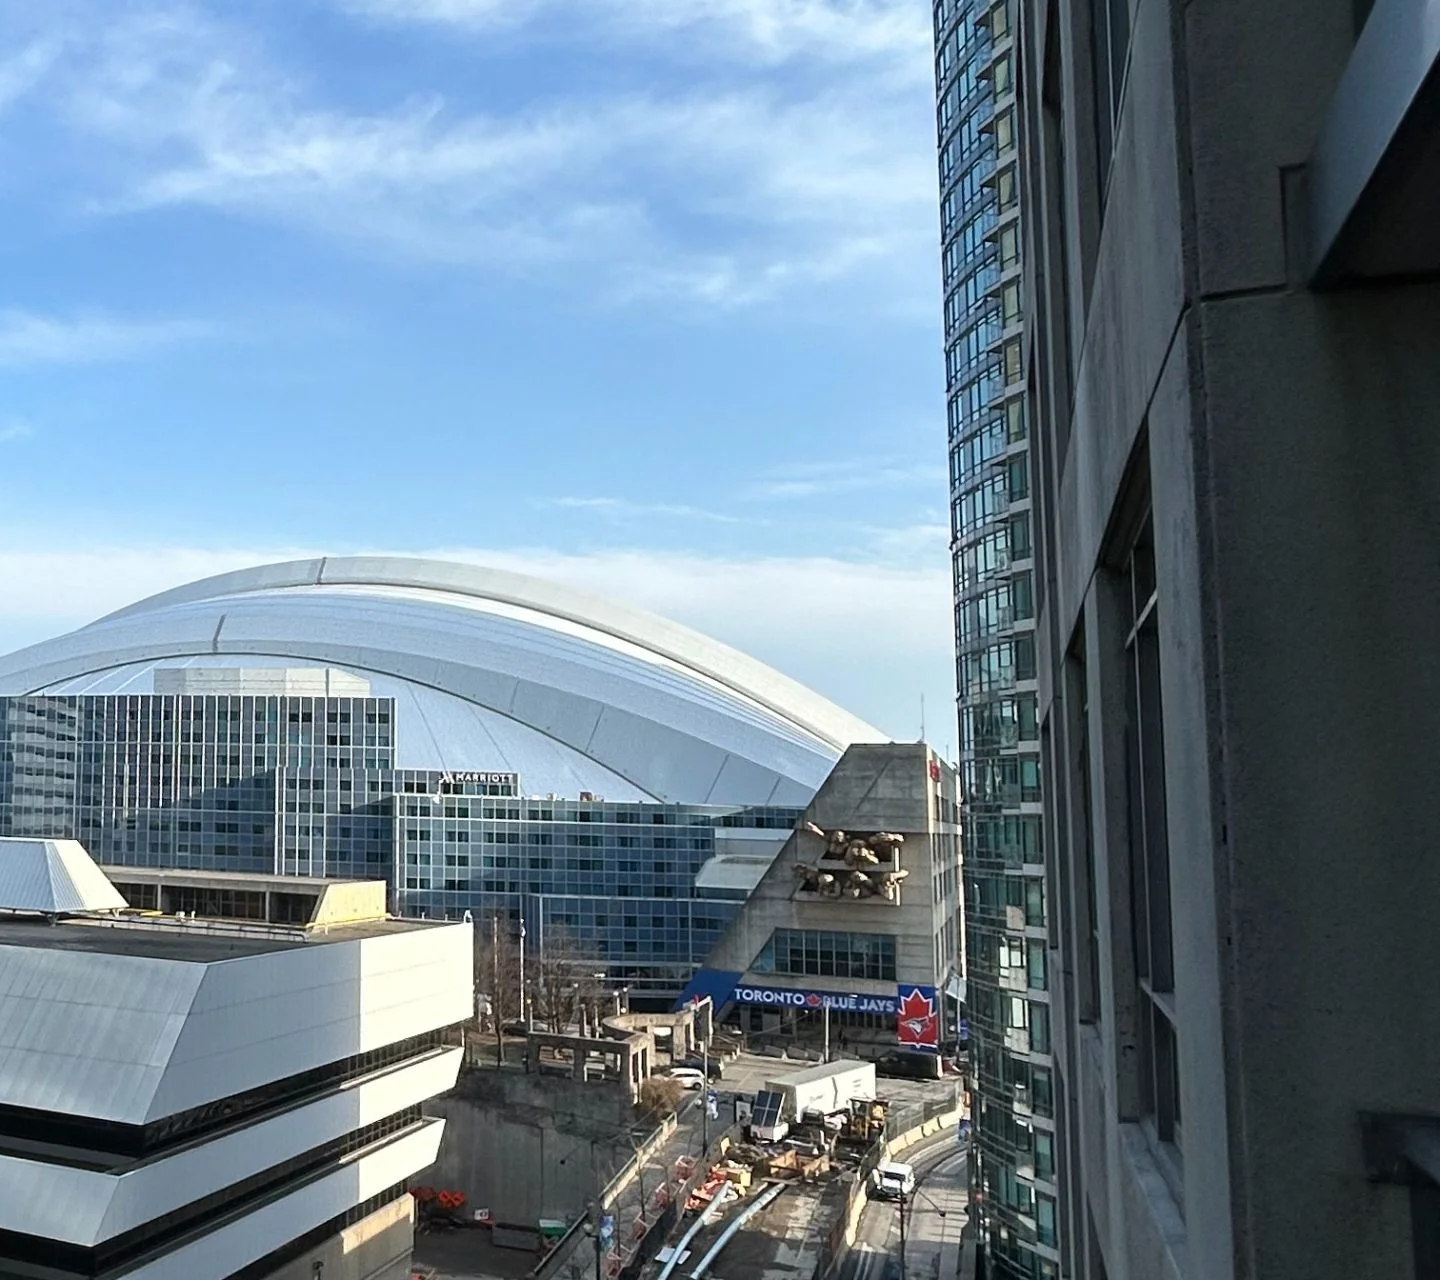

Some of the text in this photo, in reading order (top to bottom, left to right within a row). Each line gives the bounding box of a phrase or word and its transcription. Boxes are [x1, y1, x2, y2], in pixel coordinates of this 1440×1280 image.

[455, 772, 513, 783] MARRIOTT
[734, 988, 895, 1012] TORONTO BLUE JAYS
